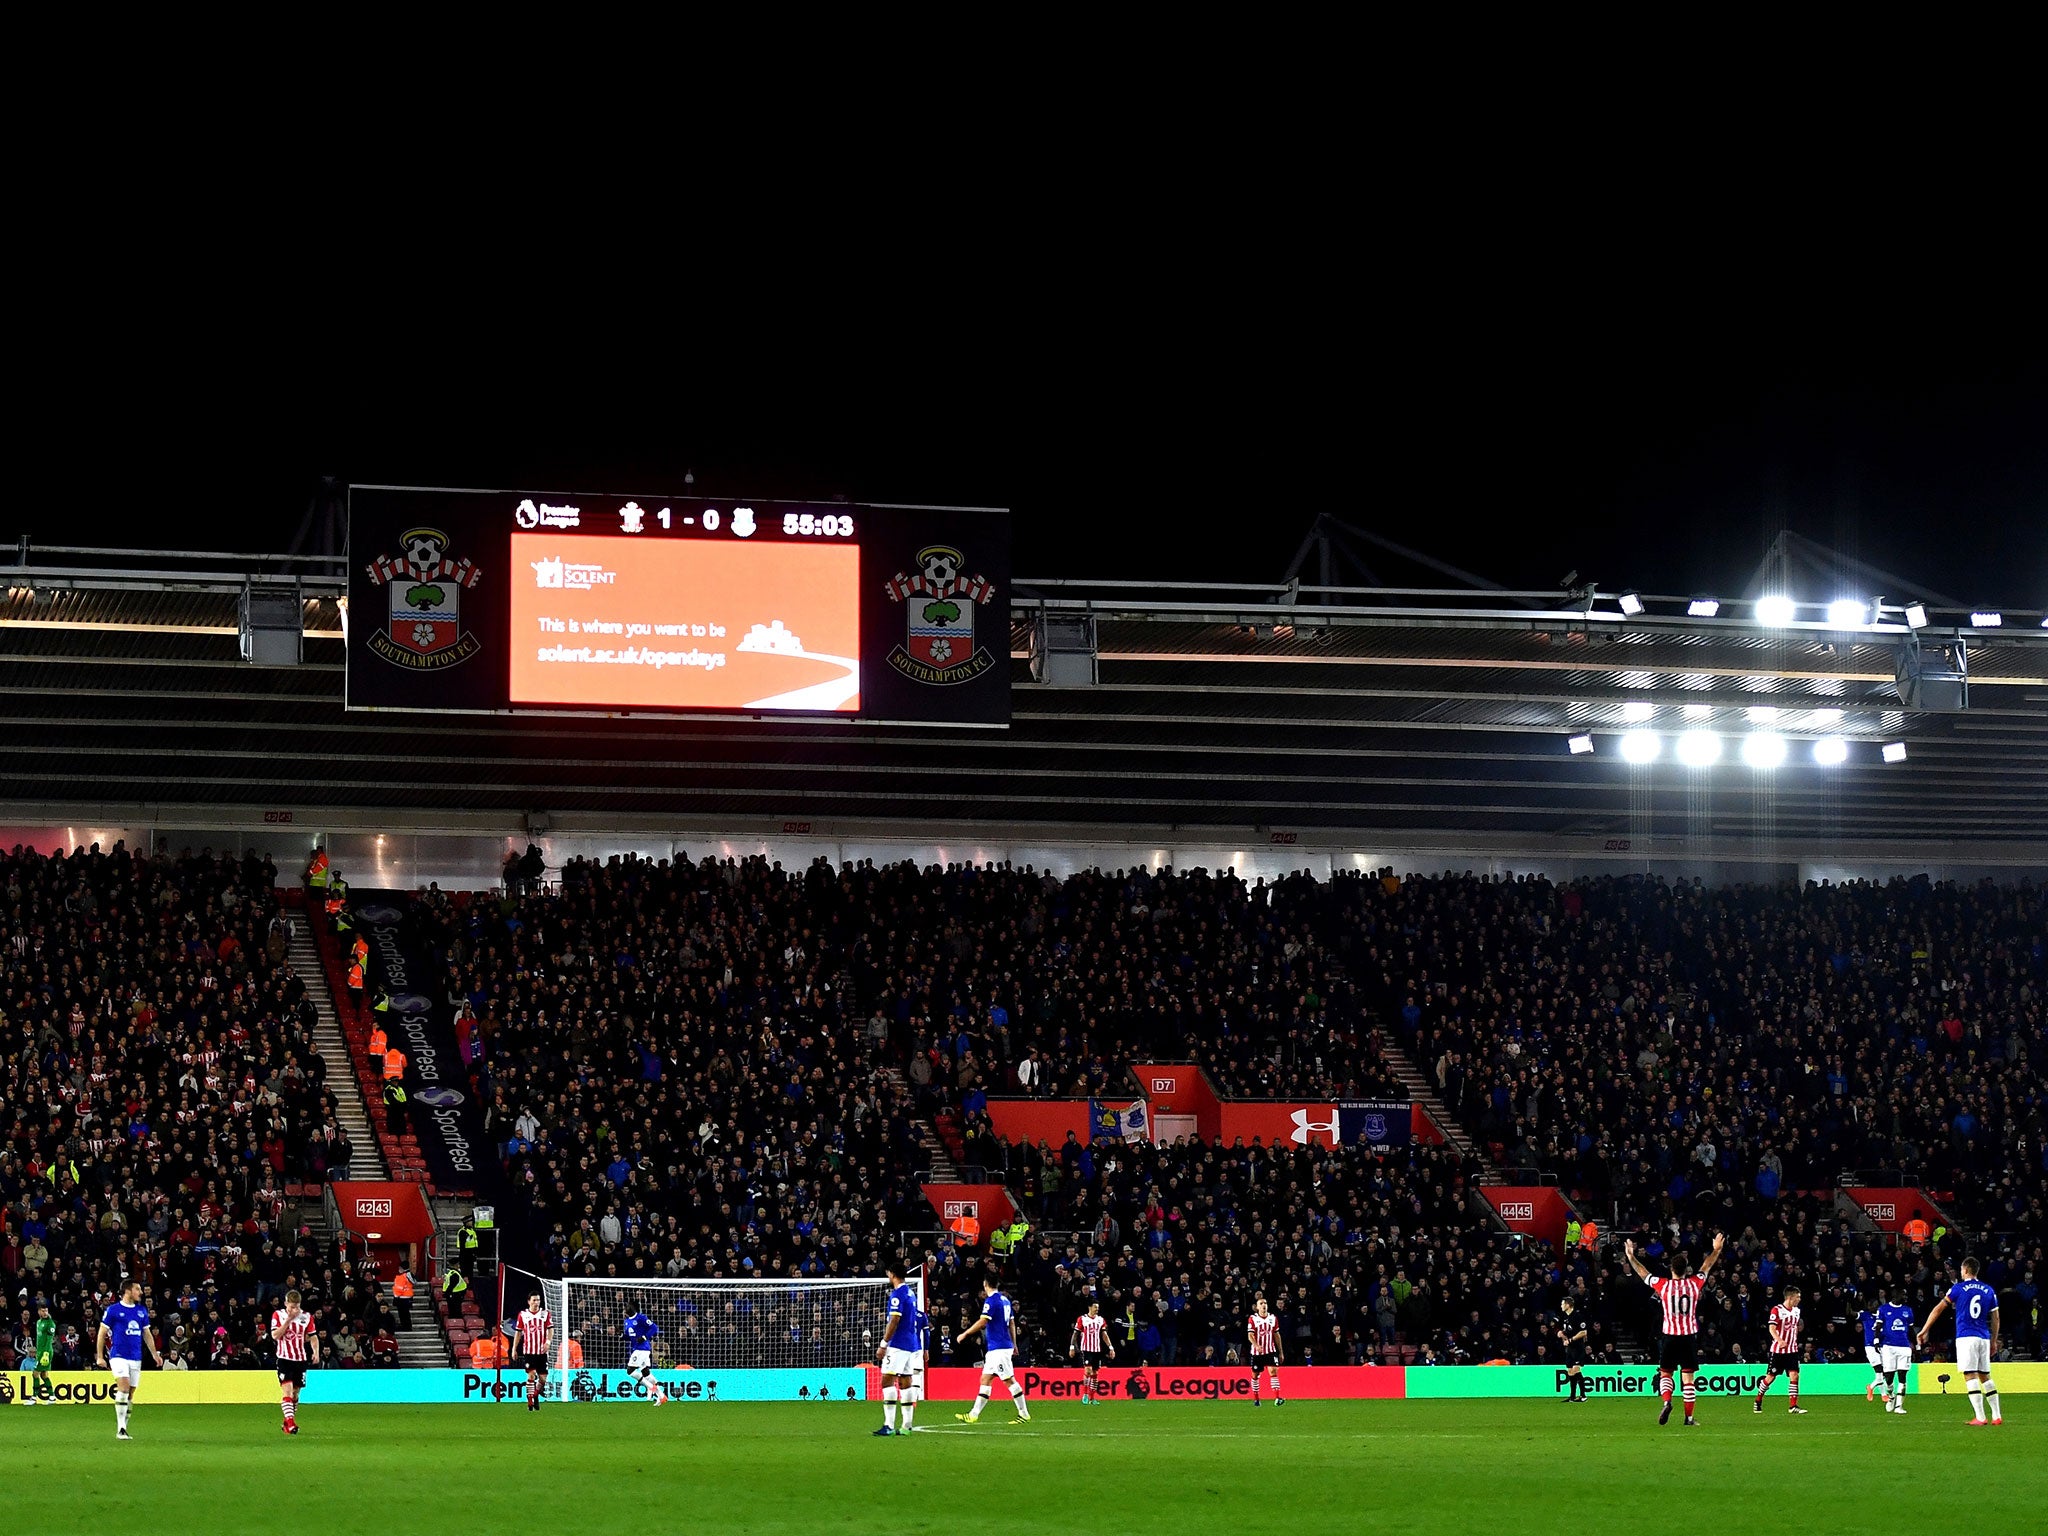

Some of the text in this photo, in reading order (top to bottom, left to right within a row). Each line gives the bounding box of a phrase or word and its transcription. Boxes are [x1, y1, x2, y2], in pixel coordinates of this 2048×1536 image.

[657, 507, 670, 528] 1
[703, 508, 720, 530] 0
[782, 513, 854, 537] 55:03
[564, 570, 616, 584] SOLENT
[538, 617, 726, 638] This is where you want to be
[374, 638, 472, 667] SOUTHAMPTON FC
[538, 643, 726, 670] solent.ac.uk/opendays
[893, 653, 988, 682] SOUTHAMPTON FC
[373, 925, 408, 986] SportPesa
[400, 1015, 440, 1081] SportPesa
[1156, 1081, 1171, 1091] D7
[431, 1108, 474, 1173] SportPesa
[359, 1203, 390, 1214] 42 43
[946, 1205, 960, 1215] 43
[1503, 1206, 1531, 1217] 44 45
[1867, 1207, 1893, 1217] 45 46
[1671, 1294, 1691, 1316] 10
[1969, 1294, 1982, 1319] 6
[20, 1376, 118, 1404] League
[464, 1374, 562, 1398] Premer
[1025, 1372, 1250, 1399] Premer League
[1556, 1369, 1767, 1397] Pemier eagu
